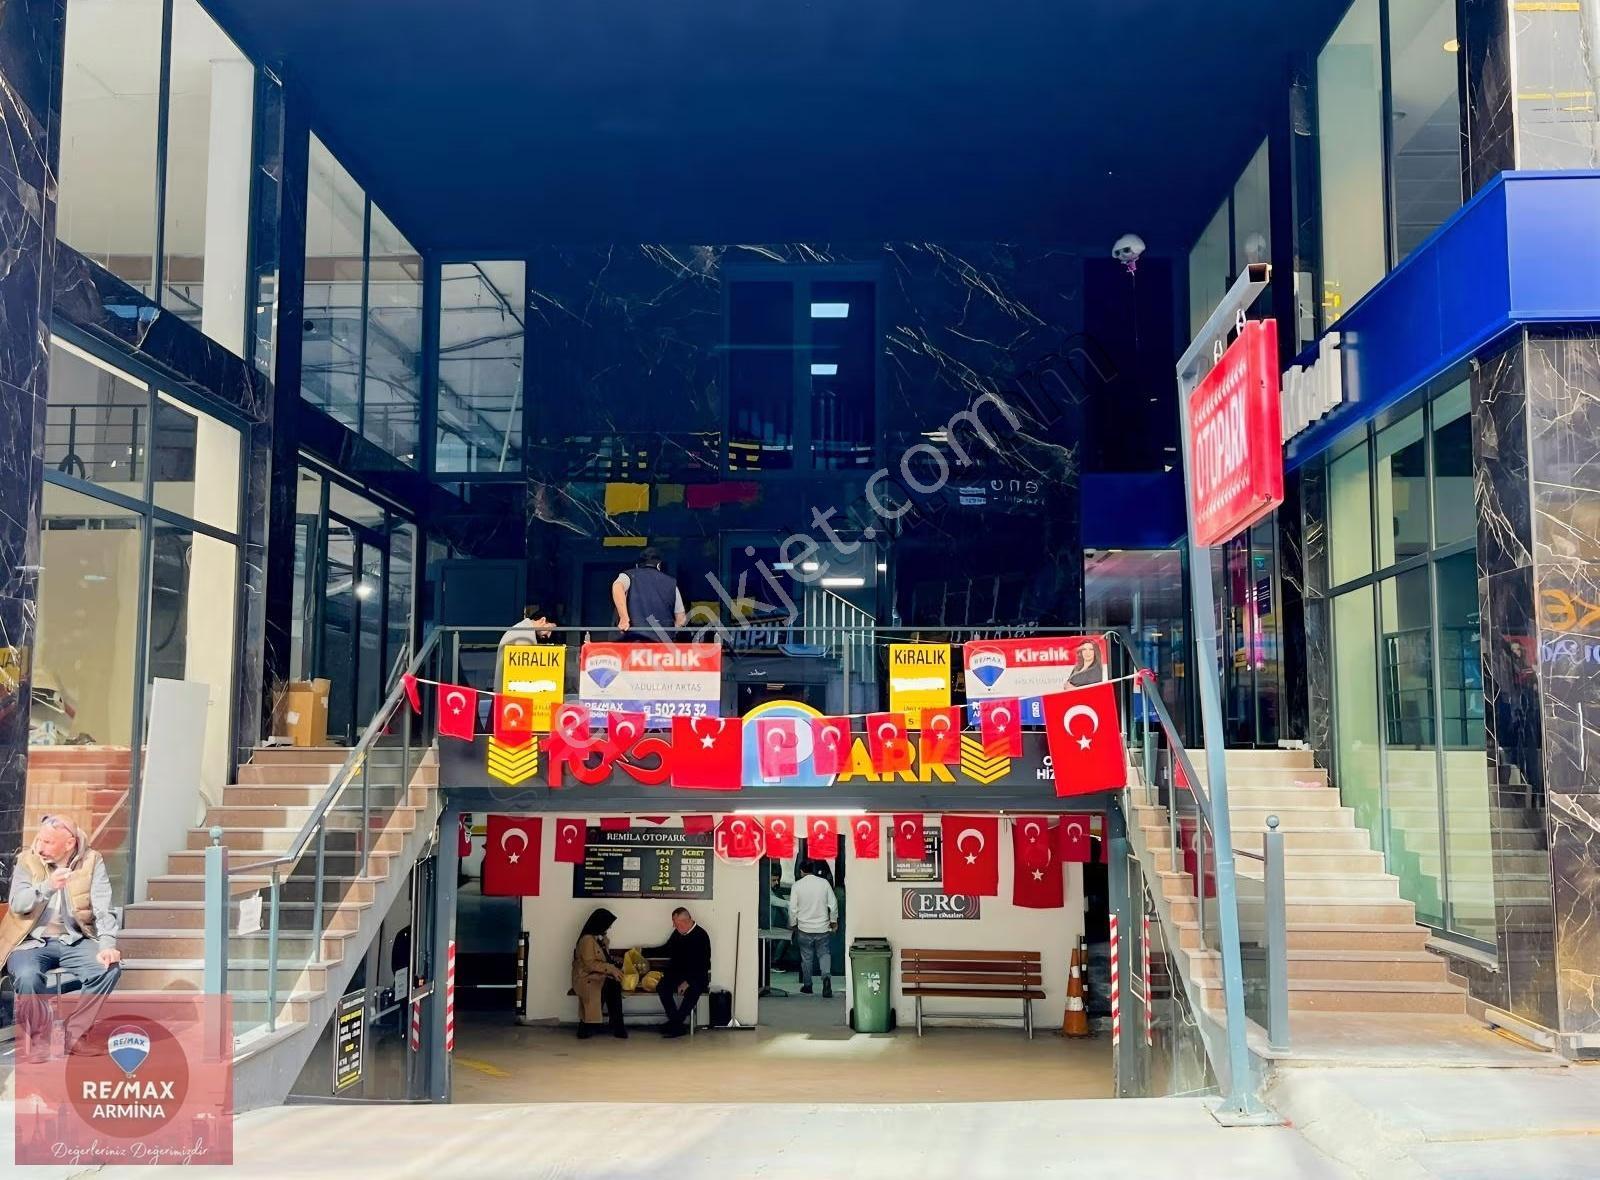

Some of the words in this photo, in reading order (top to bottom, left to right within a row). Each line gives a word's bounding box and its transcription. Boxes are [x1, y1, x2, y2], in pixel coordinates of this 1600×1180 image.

[1195, 387, 1249, 500] OTOPARK
[655, 702, 676, 716] 502
[678, 703, 693, 716] 23
[694, 703, 707, 716] 32
[642, 833, 686, 842] OTOPARK
[918, 894, 966, 912] ERC
